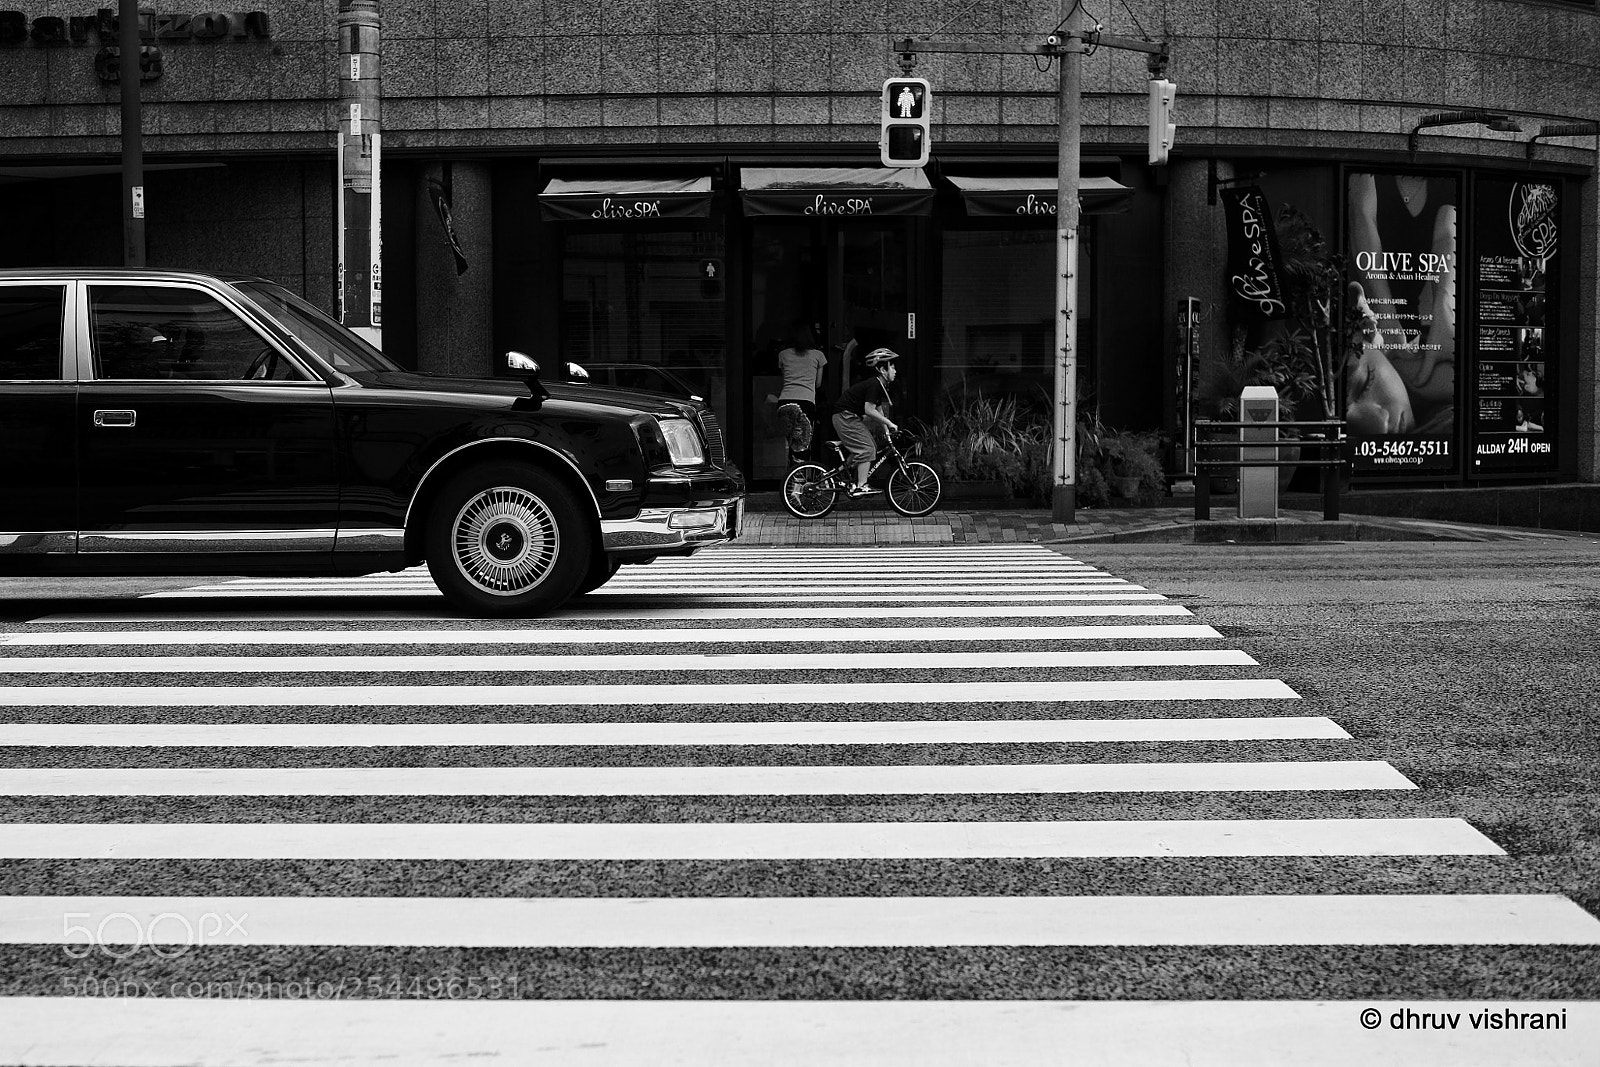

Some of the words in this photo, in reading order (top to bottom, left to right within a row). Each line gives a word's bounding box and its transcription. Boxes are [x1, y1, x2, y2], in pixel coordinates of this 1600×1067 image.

[1356, 251, 1413, 272] OLIVE
[1418, 252, 1450, 273] SPA
[1365, 271, 1388, 280] Aroma
[1388, 272, 1395, 280] &
[1395, 272, 1414, 281] Asian
[1415, 272, 1440, 284] Healing
[1361, 441, 1449, 456] 03-5467-5511
[1476, 443, 1506, 454] ALLDAY
[1508, 438, 1529, 454] 24H
[1530, 442, 1551, 453] OPEN
